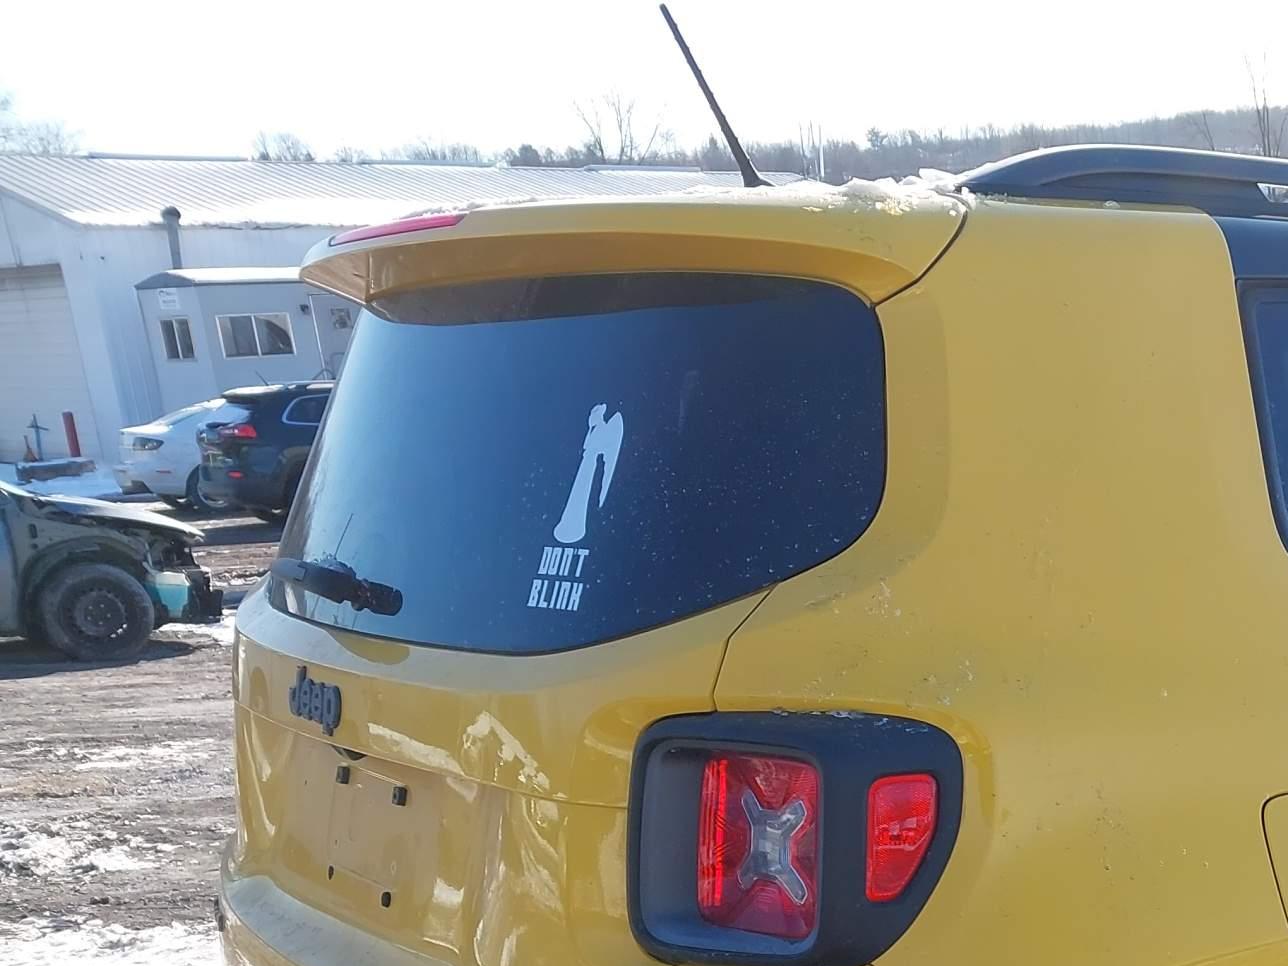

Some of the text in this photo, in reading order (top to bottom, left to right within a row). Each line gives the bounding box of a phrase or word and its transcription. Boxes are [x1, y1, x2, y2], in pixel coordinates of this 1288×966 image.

[537, 547, 590, 577] DON'T
[527, 579, 583, 611] BLINK
[289, 665, 341, 736] Jeep
